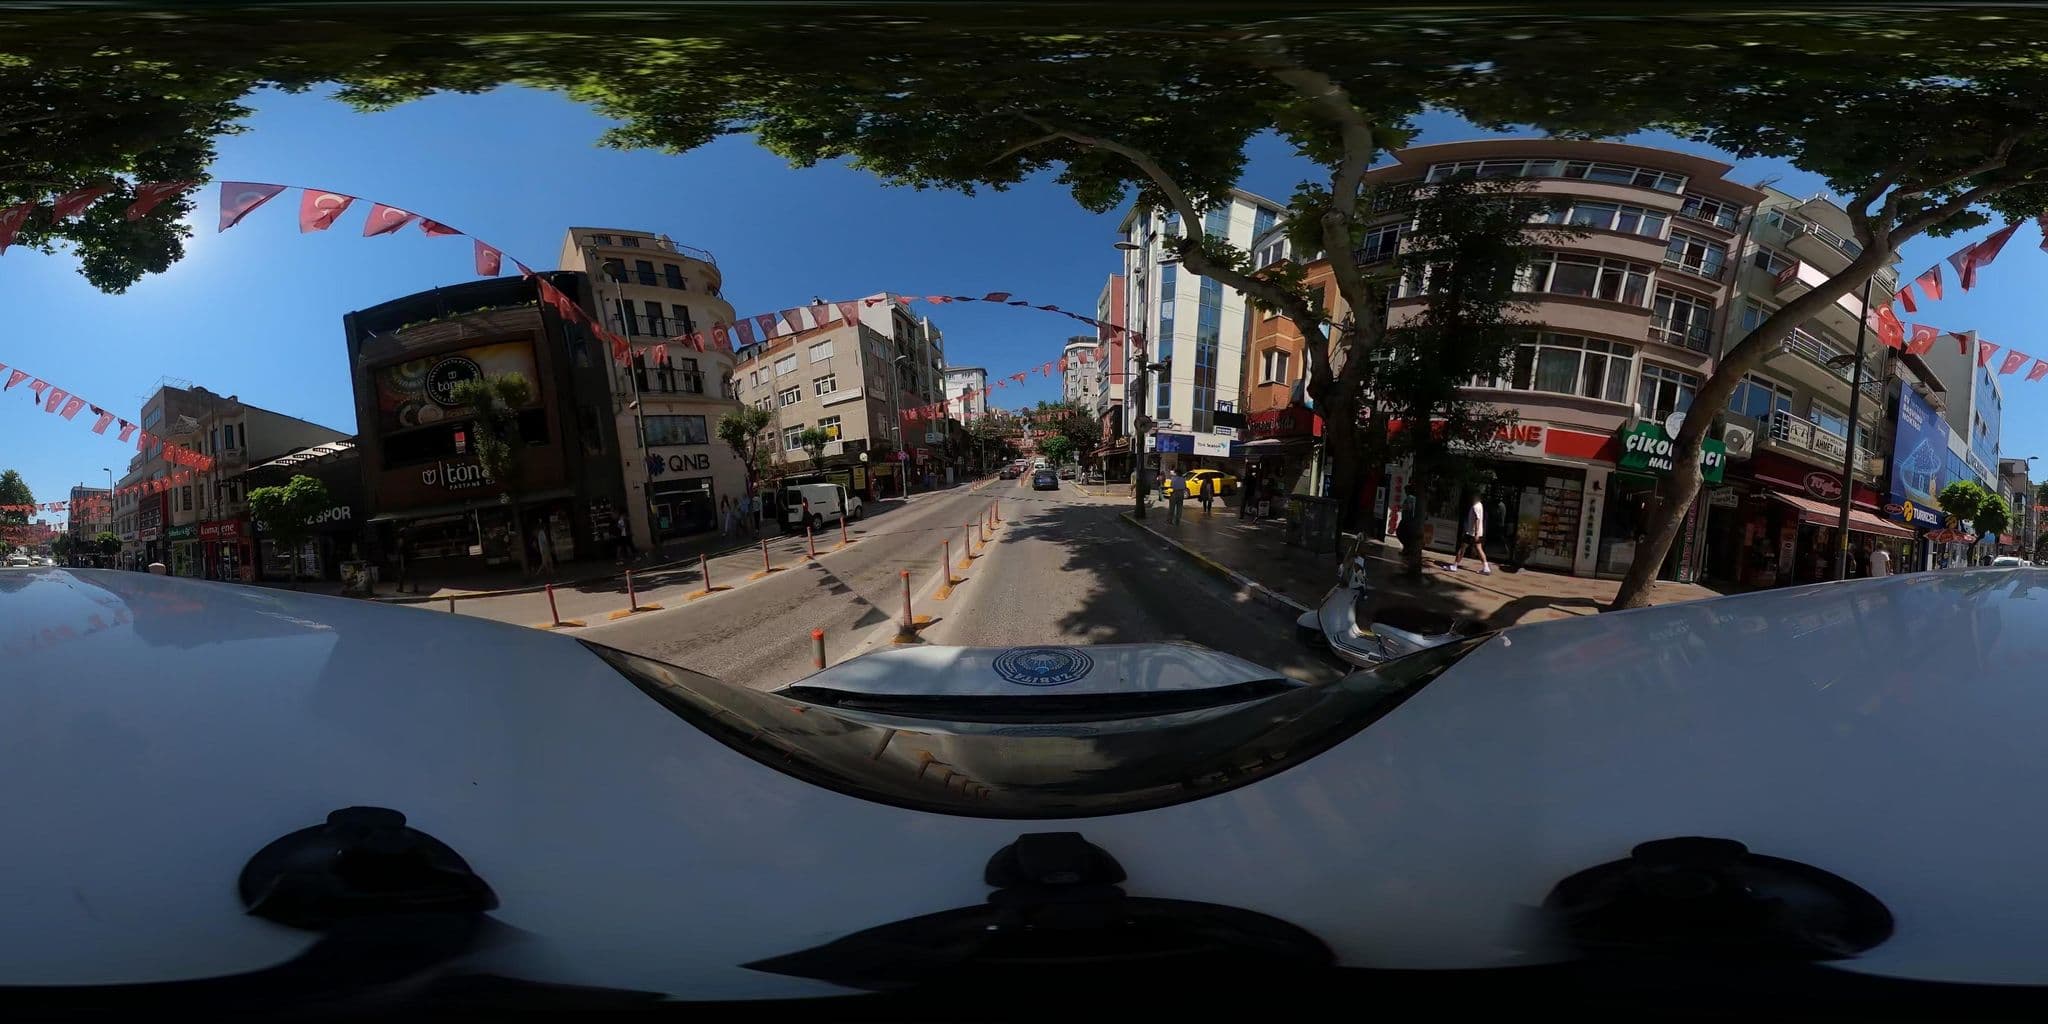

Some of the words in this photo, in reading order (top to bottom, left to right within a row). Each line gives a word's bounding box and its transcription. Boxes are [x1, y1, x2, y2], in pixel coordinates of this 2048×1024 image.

[1815, 438, 1834, 453] AHMET
[669, 453, 711, 471] QNB
[1913, 507, 1938, 525] TURKCELL
[1014, 673, 1072, 683] ZABITA
